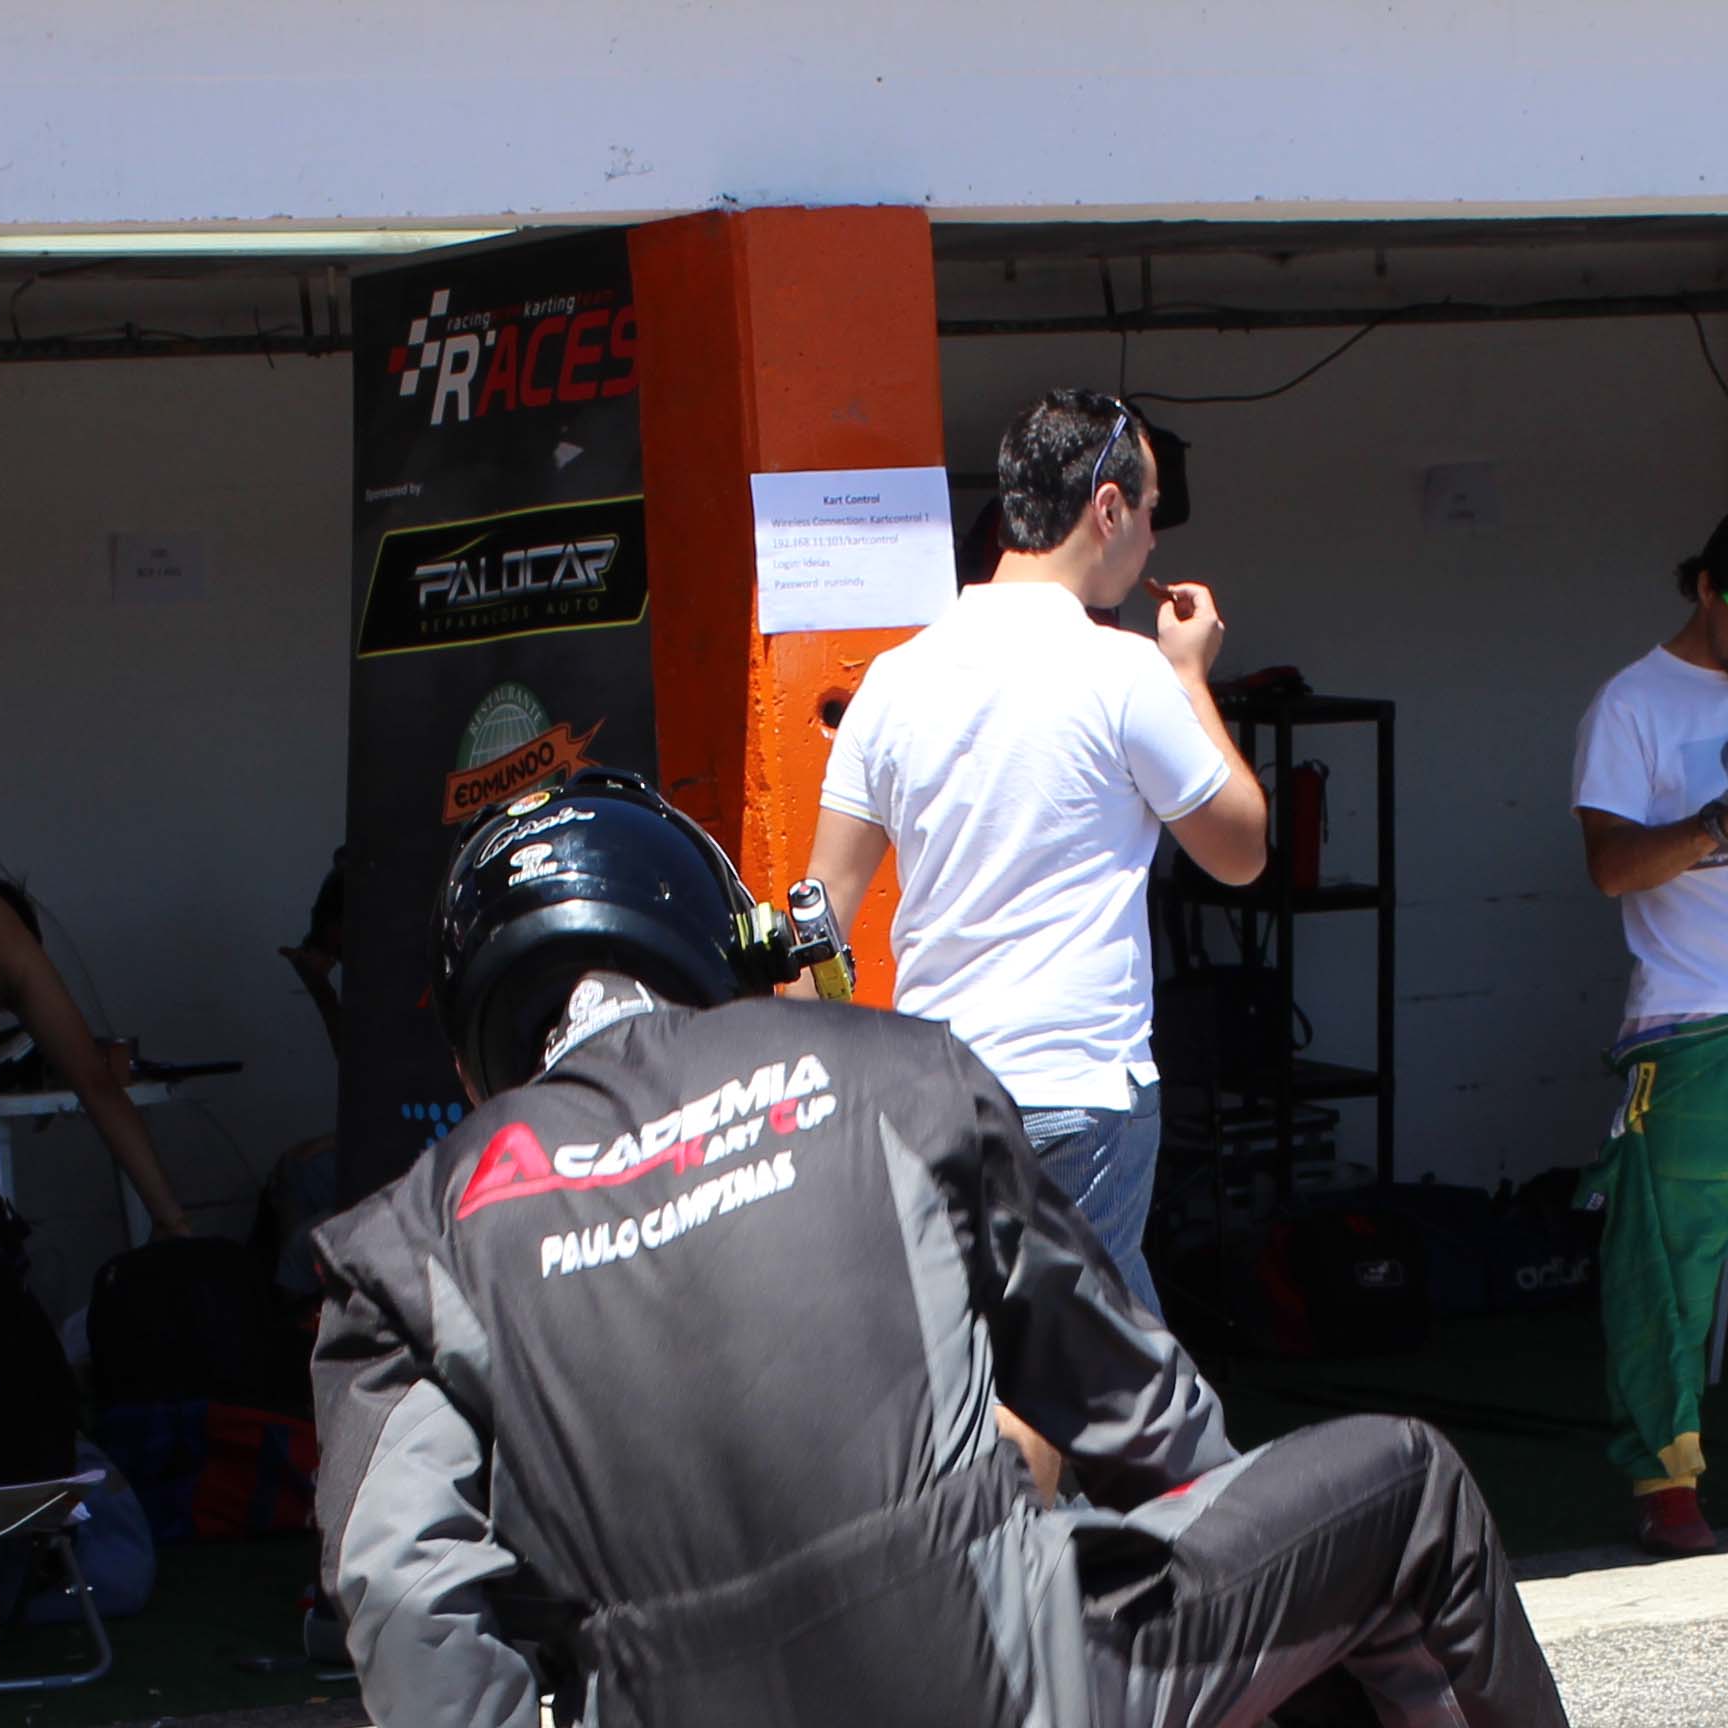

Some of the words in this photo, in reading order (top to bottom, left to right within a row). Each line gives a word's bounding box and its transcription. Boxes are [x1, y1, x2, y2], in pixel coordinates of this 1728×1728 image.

[446, 311, 492, 333] racing
[523, 295, 576, 317] karting
[772, 514, 811, 527] Wireless
[823, 495, 843, 506] Kart
[845, 493, 881, 505] Control
[414, 538, 618, 607] PALOCAR
[544, 597, 600, 617] AUTO
[454, 741, 555, 808] EDMUNDO
[456, 1053, 833, 1221] ACADEMIA
[673, 1115, 765, 1175] KART
[771, 1094, 837, 1135] CUP
[540, 1218, 640, 1279] PAULO
